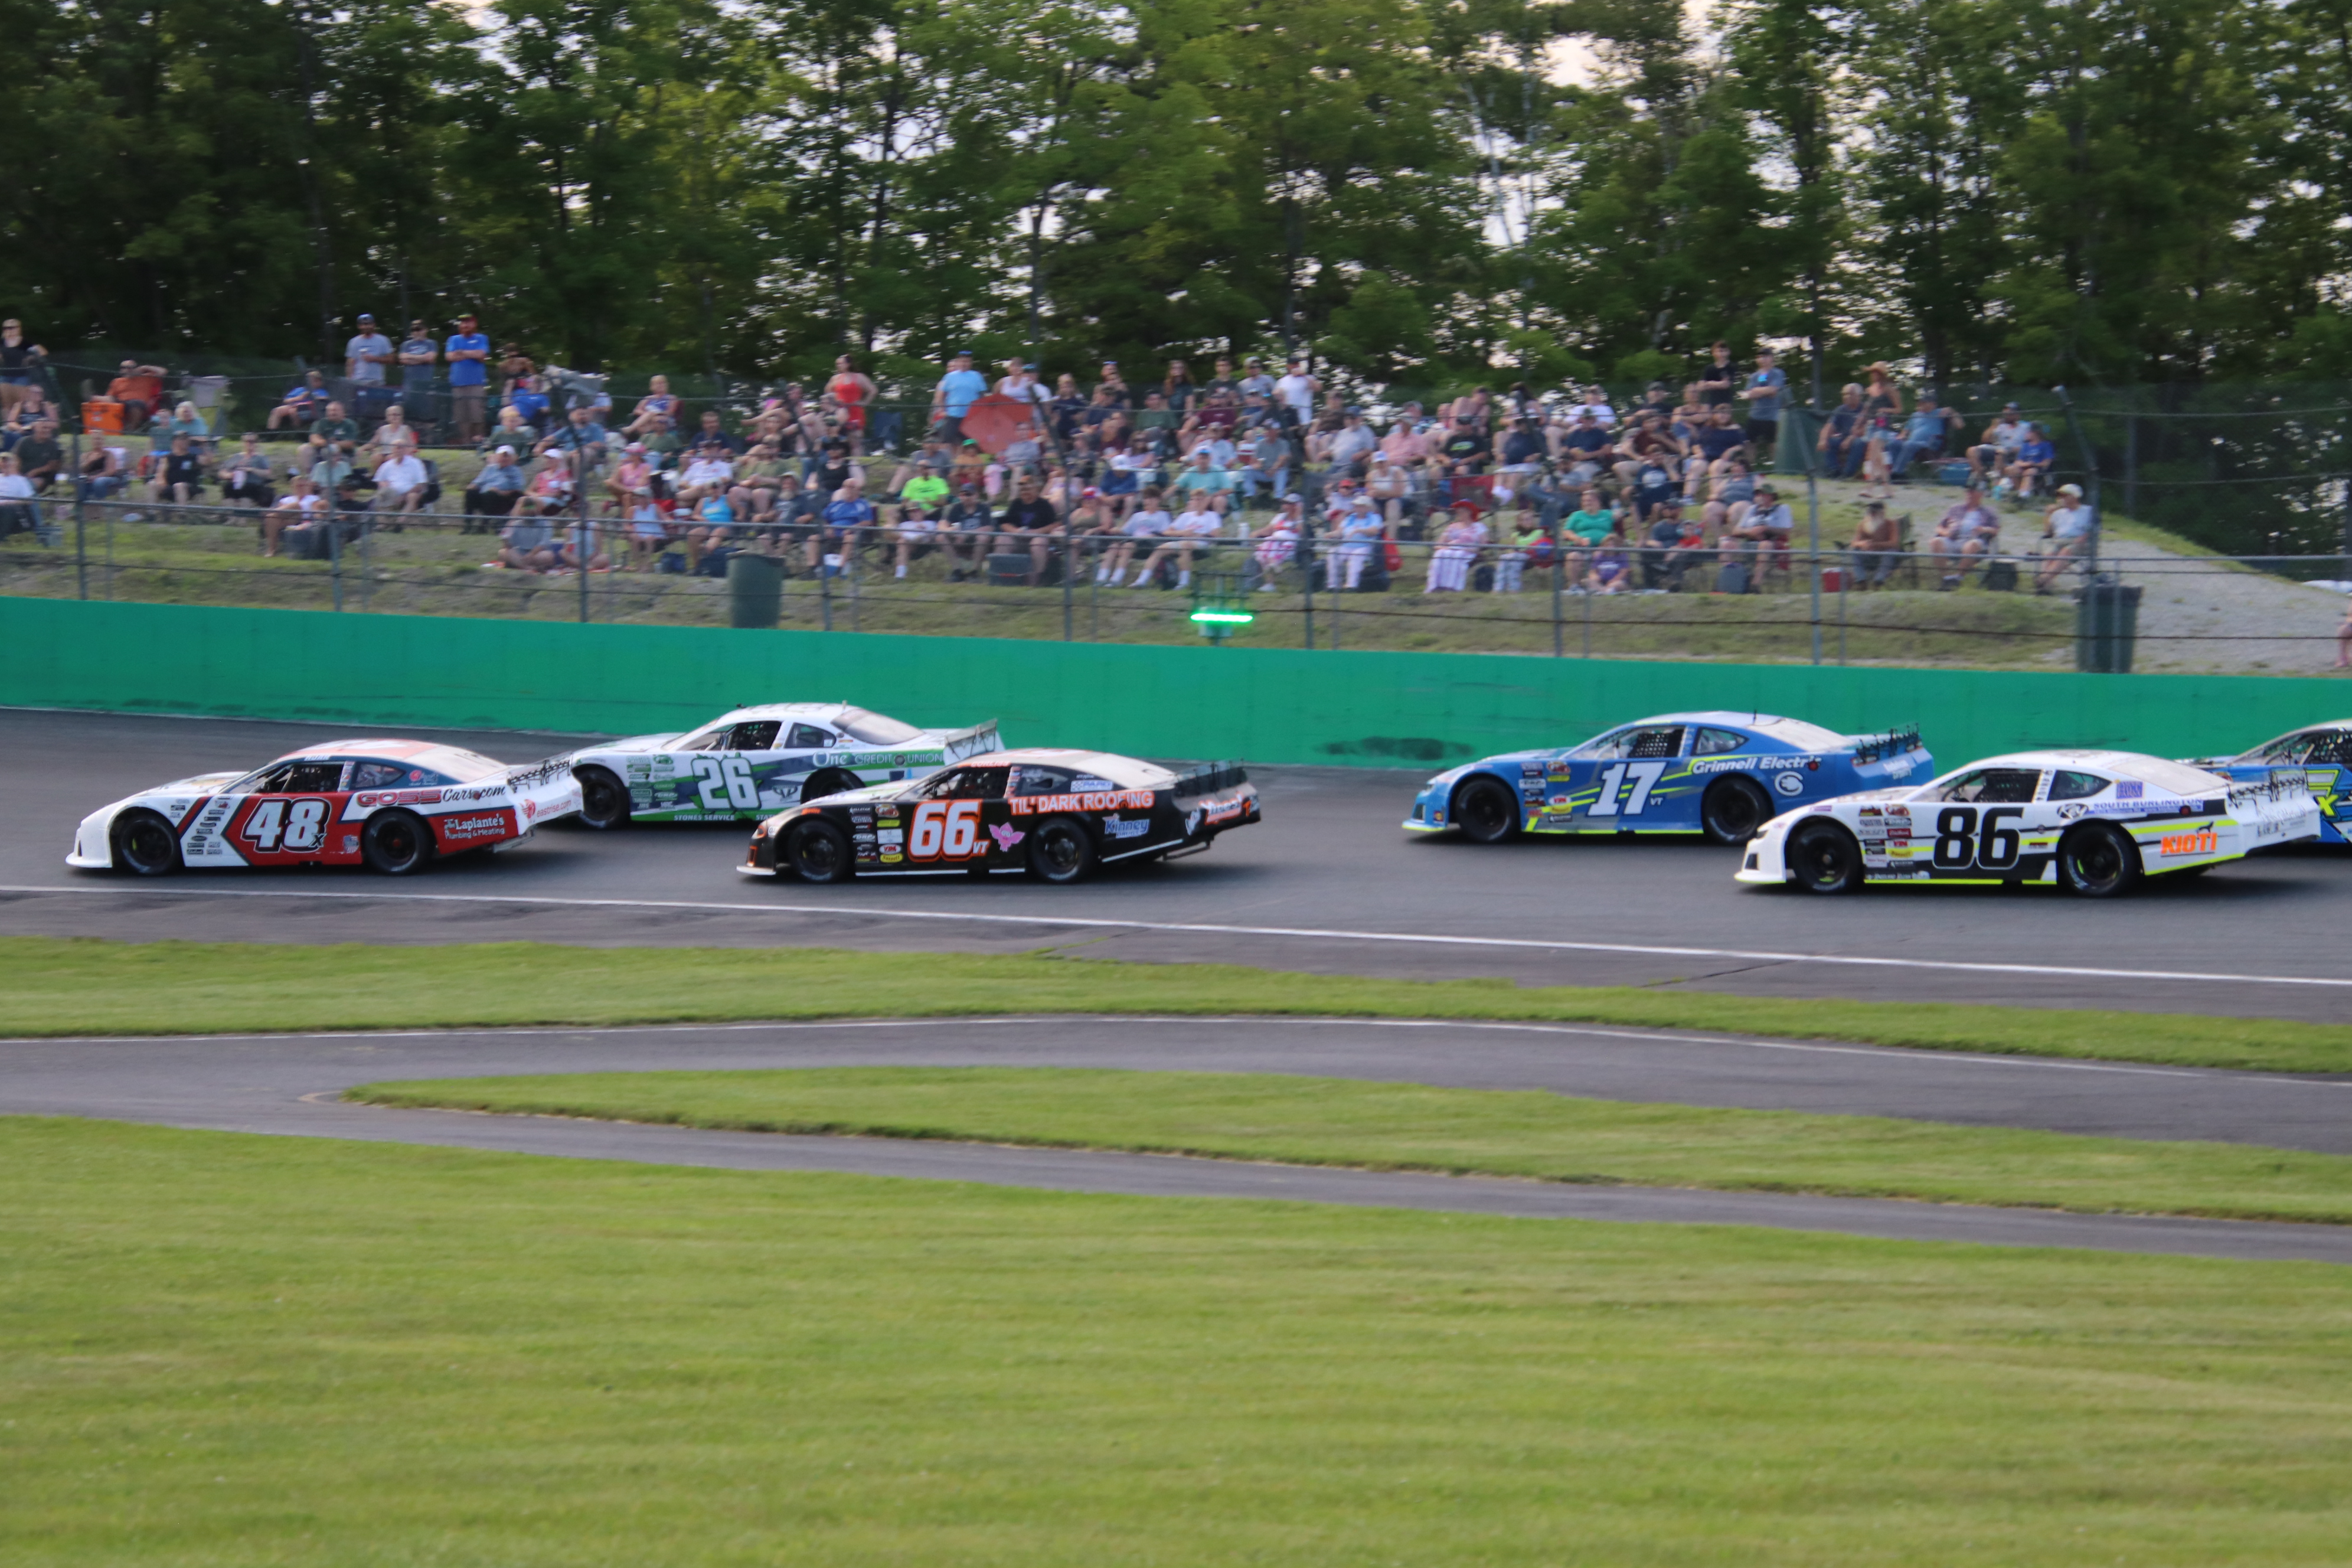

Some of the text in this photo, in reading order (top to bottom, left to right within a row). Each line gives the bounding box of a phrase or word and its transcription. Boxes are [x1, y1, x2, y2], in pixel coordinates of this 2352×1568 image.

[813, 752, 943, 767] One CREDIT UNION
[1693, 757, 1758, 774] Grinnell
[691, 757, 762, 810] 26
[1587, 761, 1667, 816] 17
[357, 786, 506, 807] GOSS Carscom
[1038, 795, 1081, 812] DARK
[241, 798, 331, 852] 48
[454, 814, 505, 831] Laplante's
[478, 828, 505, 836] Heating
[908, 799, 989, 861] 66 VT
[1105, 818, 1149, 833] Kinney
[1933, 806, 2024, 869] 86
[2160, 832, 2217, 855] KIOTI
